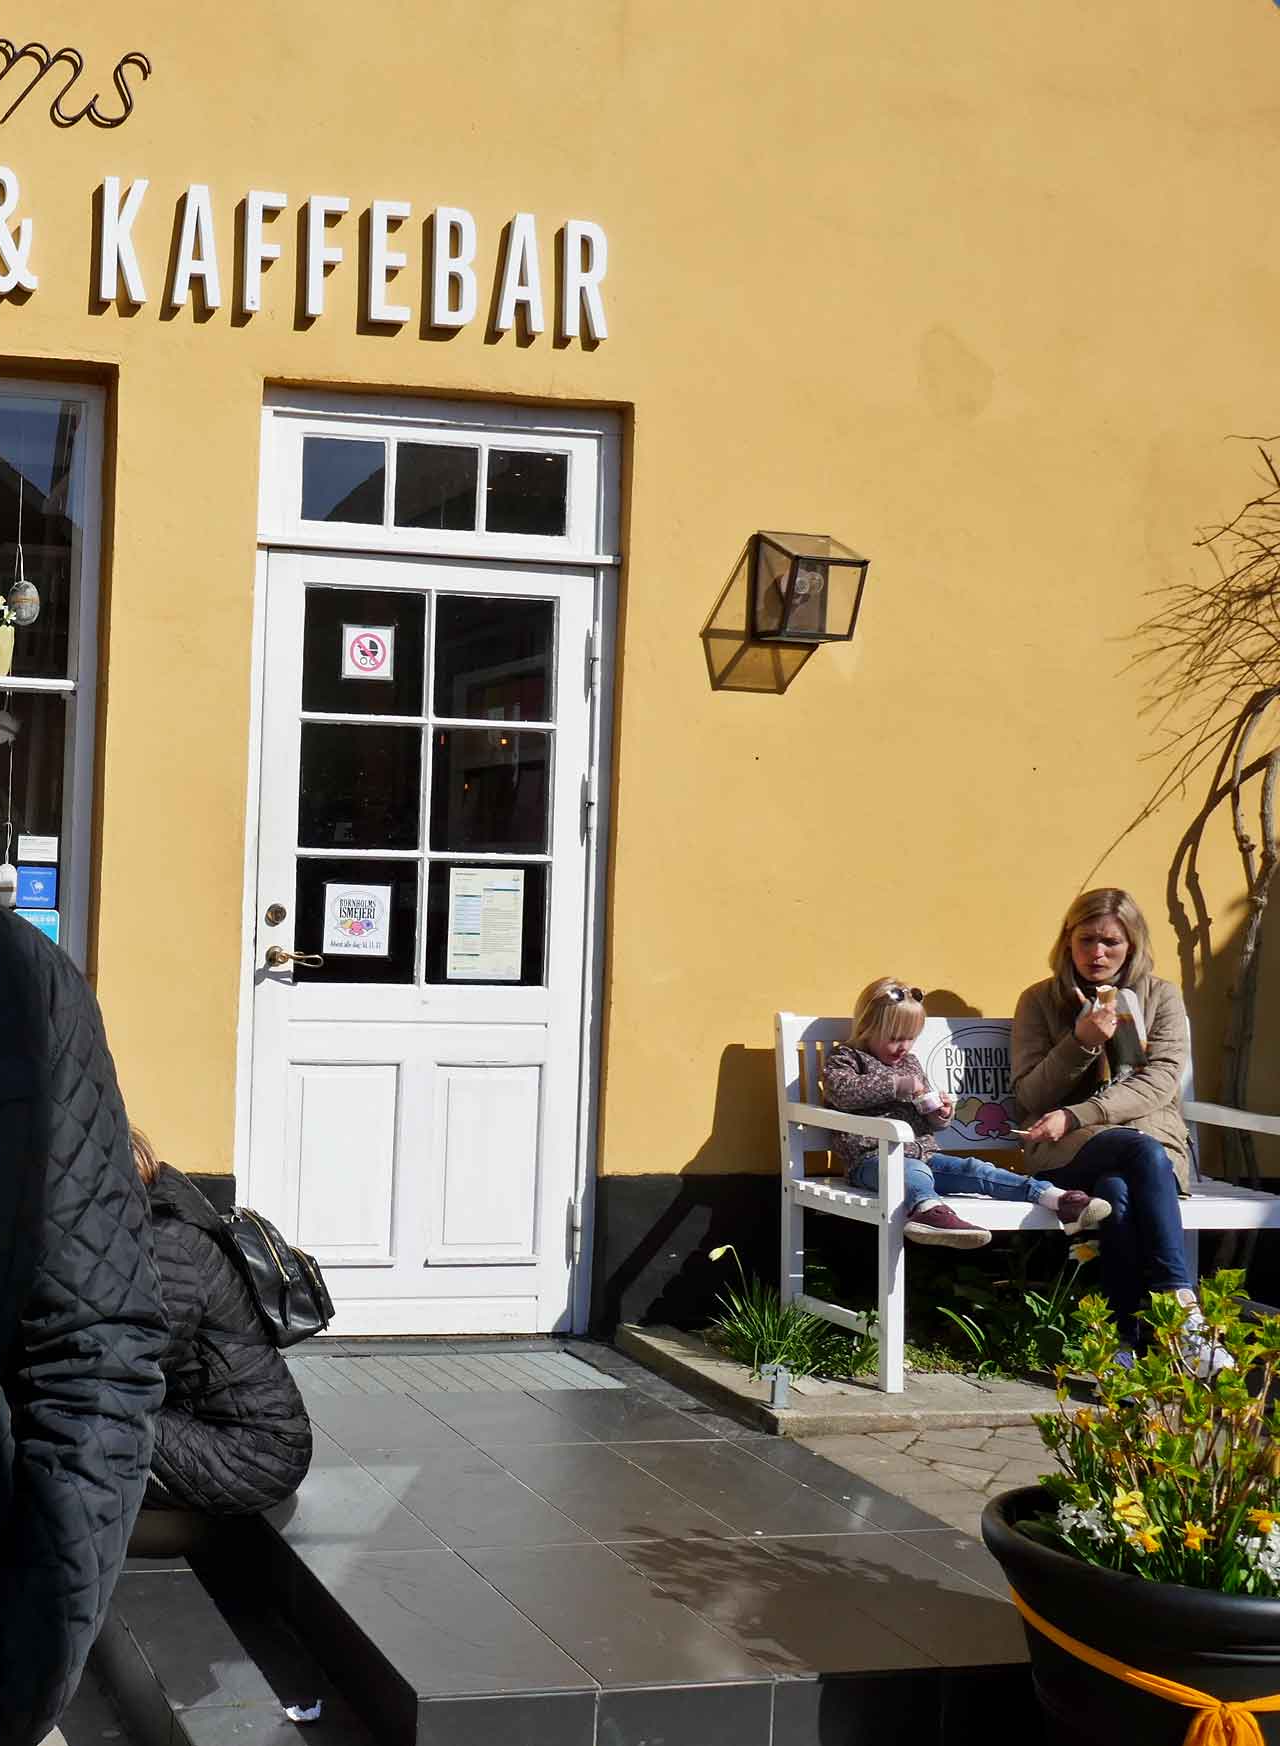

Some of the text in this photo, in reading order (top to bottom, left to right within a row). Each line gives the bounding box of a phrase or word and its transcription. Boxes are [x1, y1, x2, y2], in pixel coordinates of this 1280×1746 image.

[98, 175, 608, 342] KAFFEBAR
[339, 898, 377, 908] BORNHOLMS
[339, 907, 376, 921] ISMEJERI
[943, 1047, 1011, 1067] BORNHOL
[945, 1067, 1012, 1101] ISMEJE
